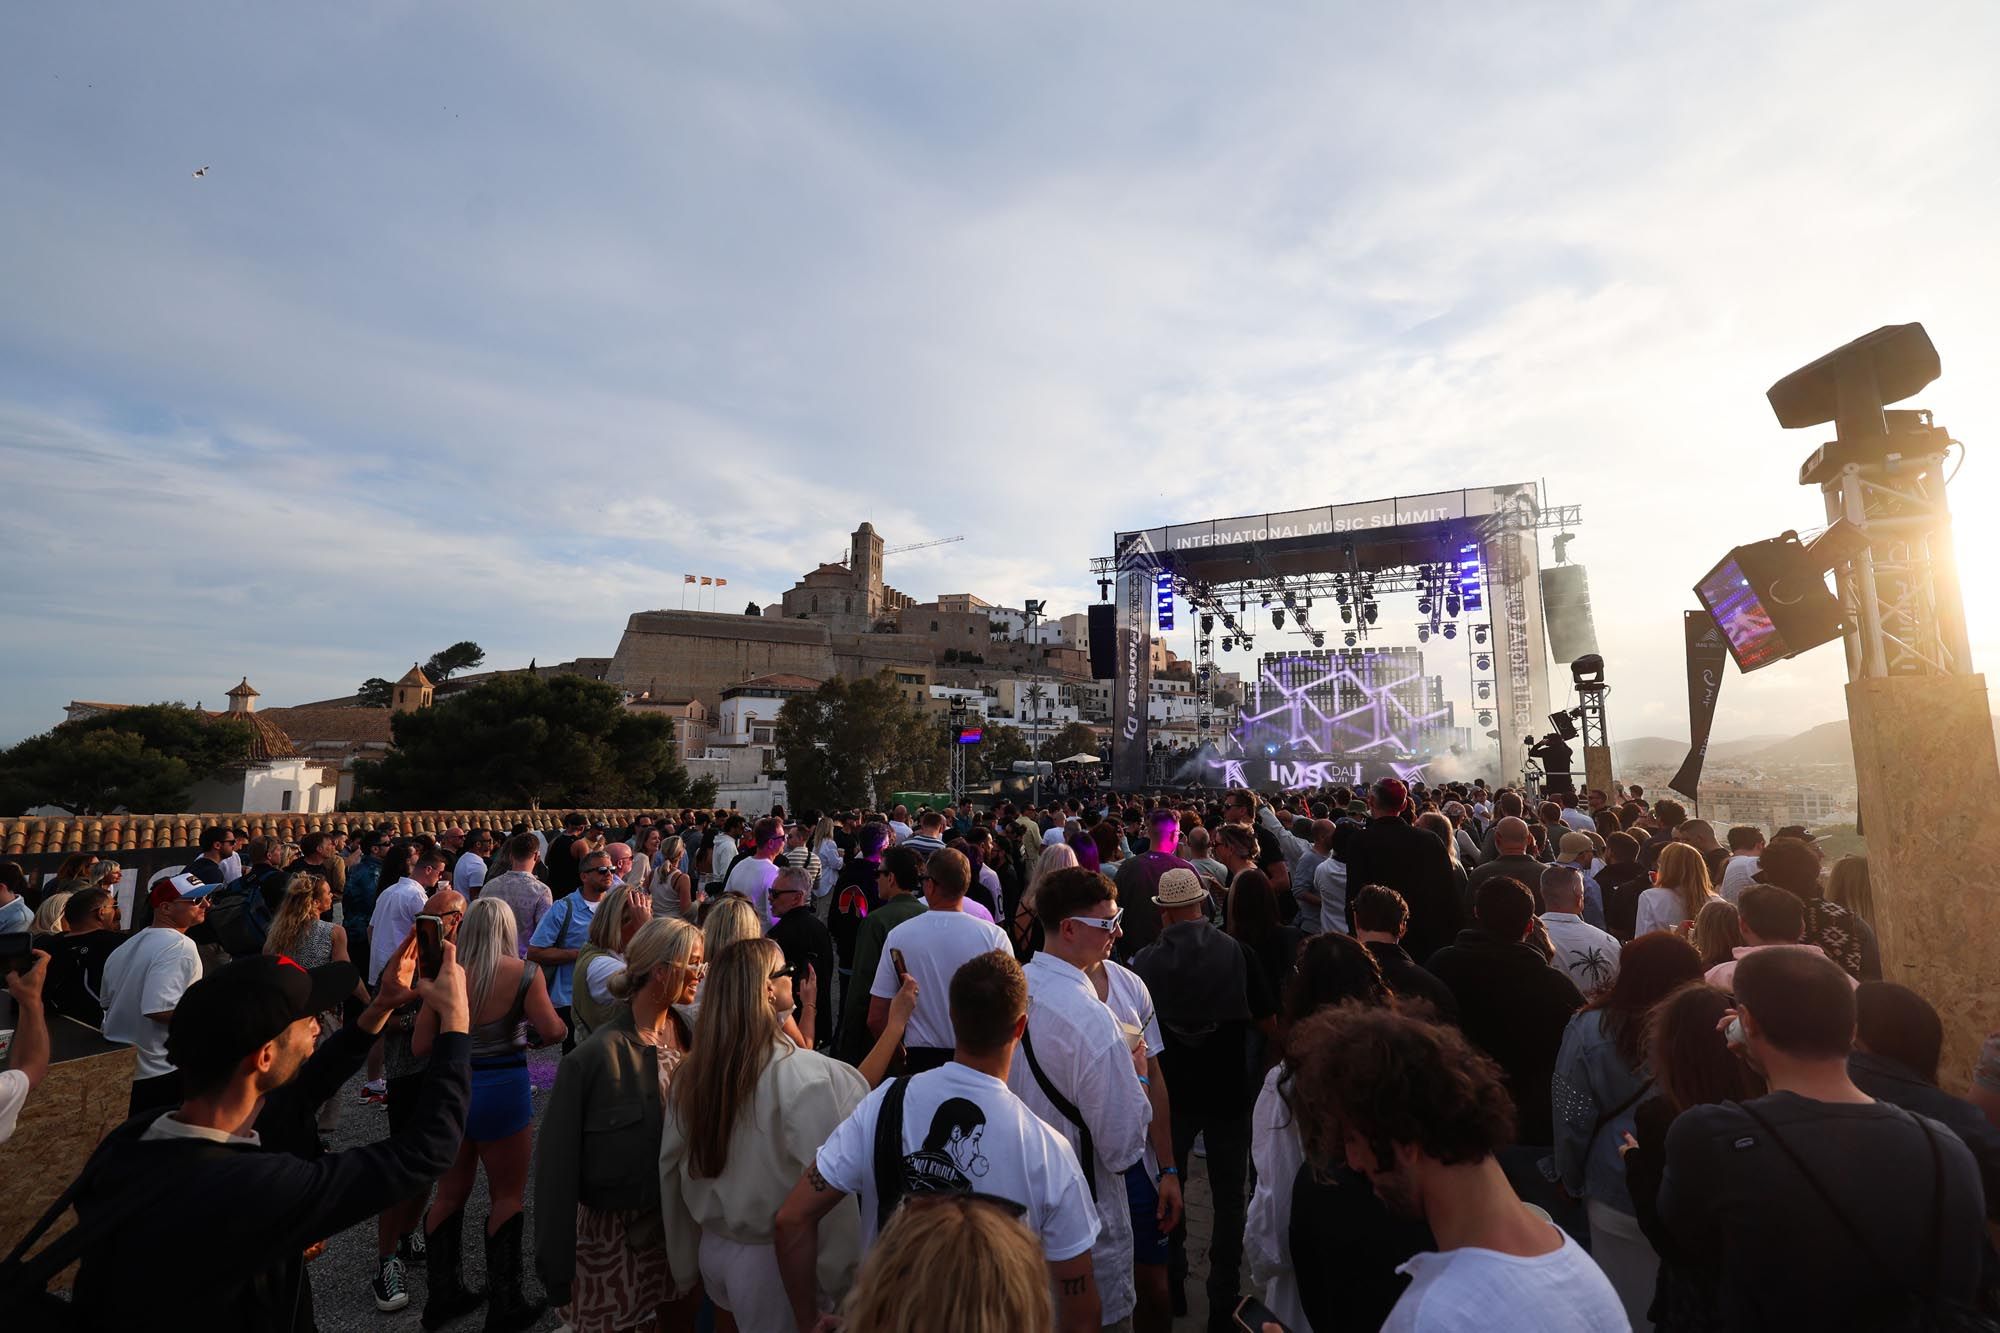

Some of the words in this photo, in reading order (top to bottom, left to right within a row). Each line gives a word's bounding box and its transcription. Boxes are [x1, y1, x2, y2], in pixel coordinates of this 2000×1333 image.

[1177, 525, 1302, 550] INTERNATIONAL
[1308, 517, 1364, 536] MUSIC
[1371, 506, 1448, 528] SUMMIT
[1128, 622, 1142, 712] Pioneer
[1270, 760, 1323, 788] IMS
